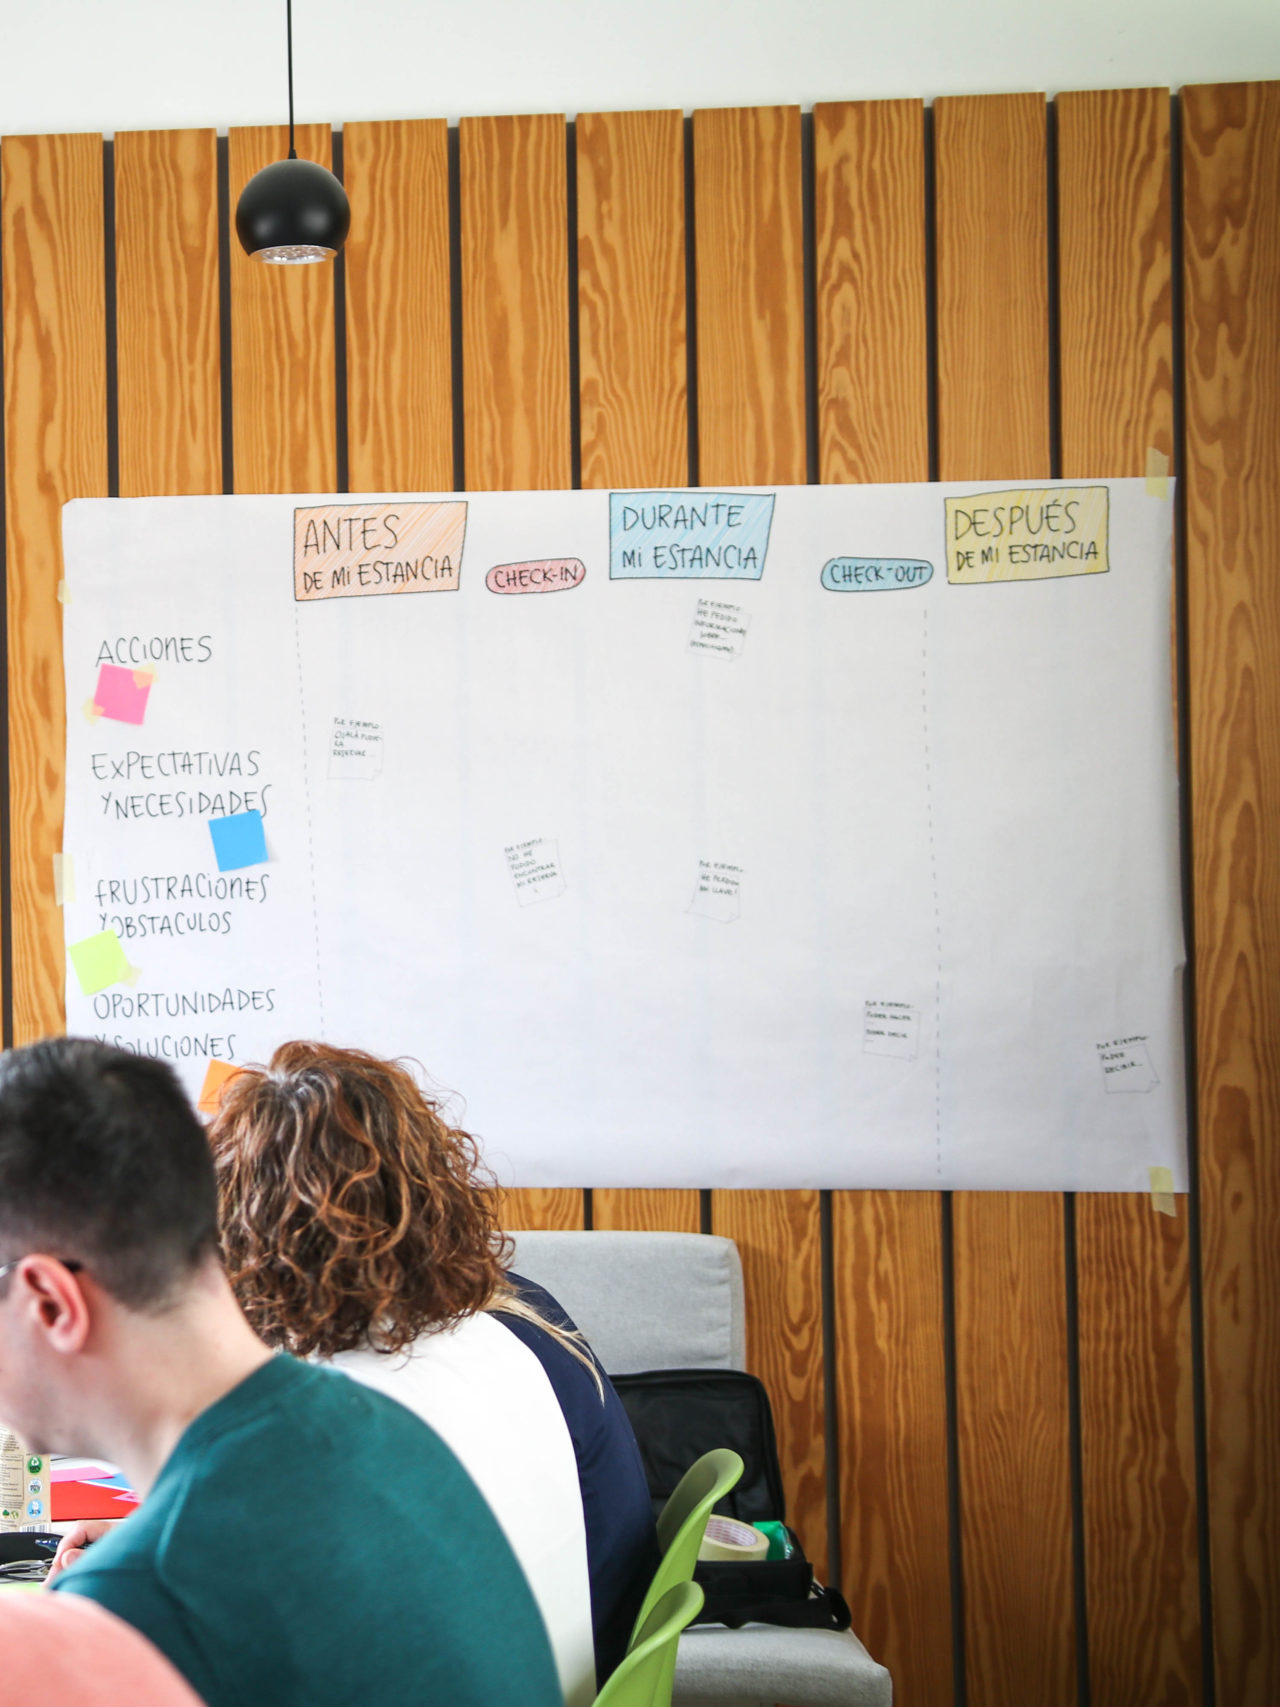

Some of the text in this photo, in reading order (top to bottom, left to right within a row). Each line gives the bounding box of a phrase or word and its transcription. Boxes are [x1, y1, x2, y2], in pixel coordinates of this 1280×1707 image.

[623, 502, 745, 531] DURANTE
[954, 499, 1080, 541] DESPUÉS
[304, 514, 400, 557] ANTES
[653, 543, 758, 570] ESTANCIA
[956, 540, 1099, 571] DE MI ESTANCIA
[303, 571, 324, 593] DE
[357, 555, 453, 586] ESTANCIA
[494, 564, 580, 588] CHECK-IN
[830, 563, 929, 585] CHECK-OUT
[95, 635, 213, 668] ACCIONES
[91, 750, 262, 780] EXPECTATIVAS
[93, 988, 276, 1020] OPORTUNIDADES
